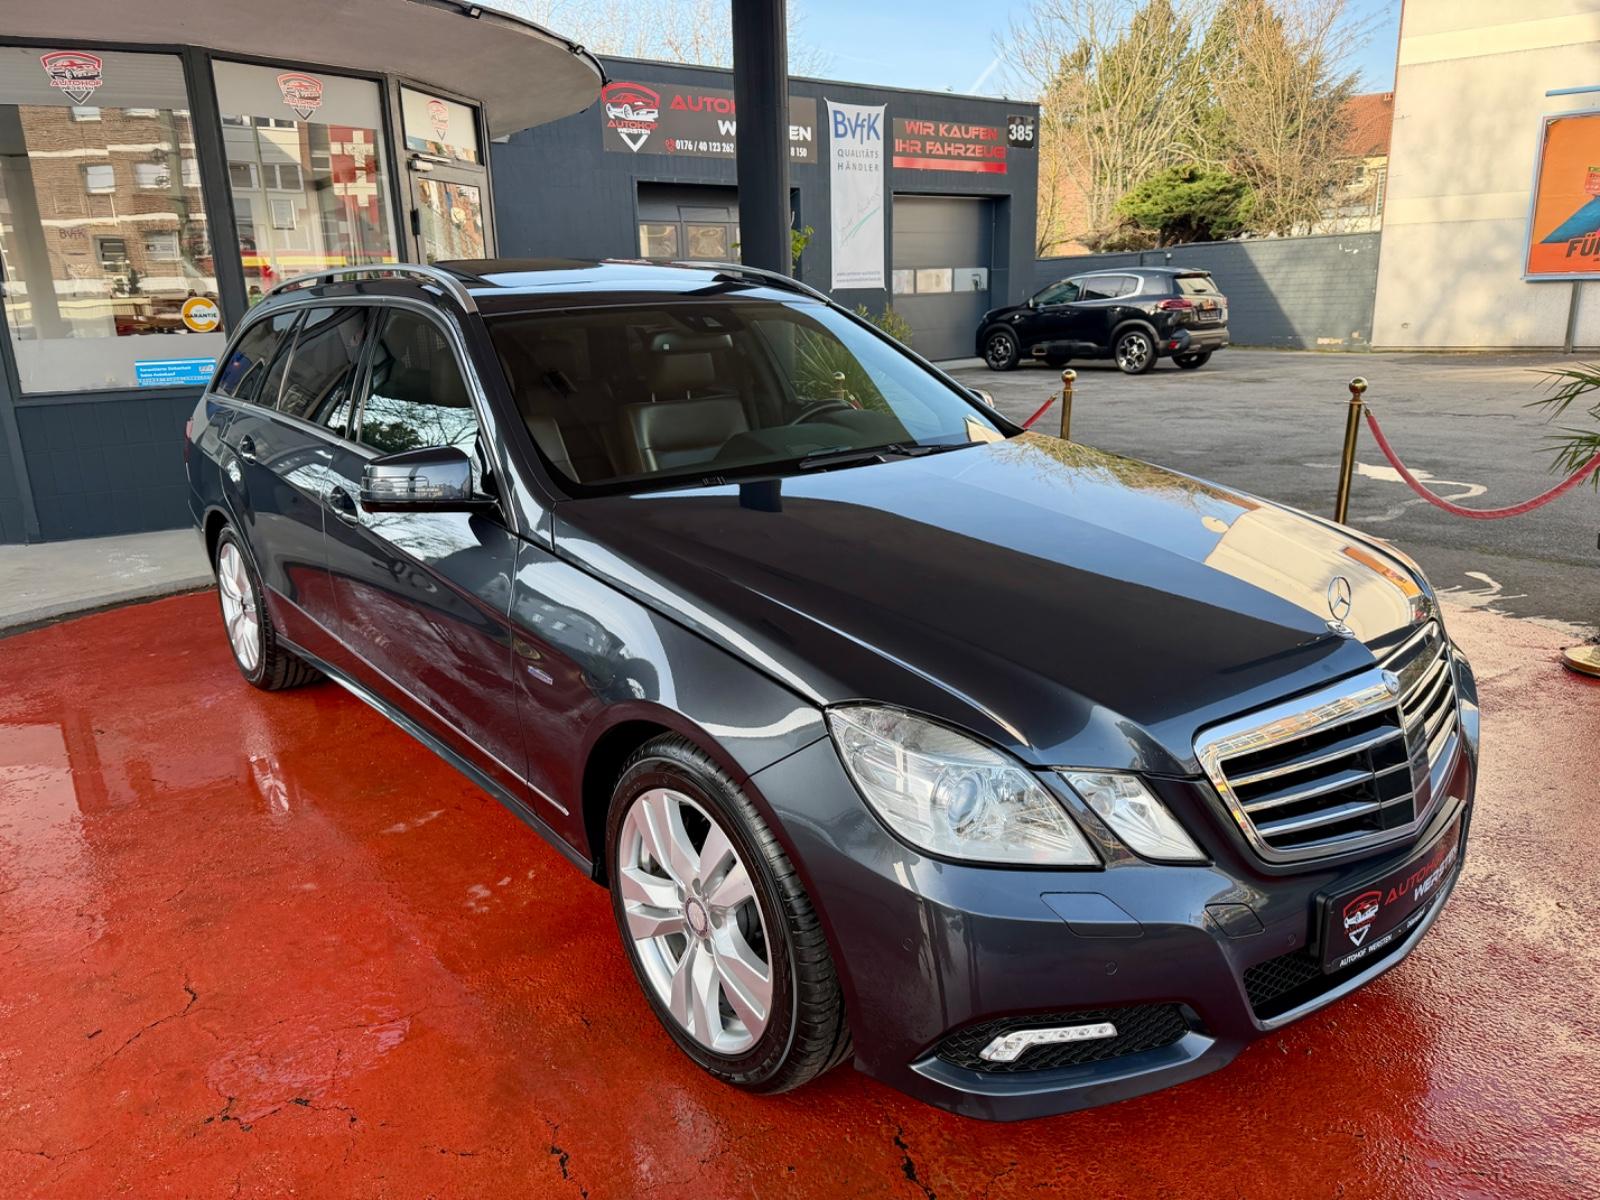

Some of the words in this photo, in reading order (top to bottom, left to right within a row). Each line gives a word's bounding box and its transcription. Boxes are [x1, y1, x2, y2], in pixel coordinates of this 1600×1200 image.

[607, 119, 658, 129] AUTOHOF
[905, 121, 934, 136] WIR
[940, 123, 998, 140] KAUFEN
[1008, 124, 1033, 141] 385
[675, 139, 692, 151] 0176
[698, 141, 708, 152] 40
[709, 142, 721, 153] 123
[722, 142, 735, 153] 262
[796, 147, 807, 157] 150
[837, 148, 879, 159] QUALITÄTS
[895, 139, 922, 154] IHR
[926, 141, 1007, 159] FAHRZEUG
[837, 161, 879, 172] HÄNDLER
[1339, 947, 1367, 967] AUTOHOF
